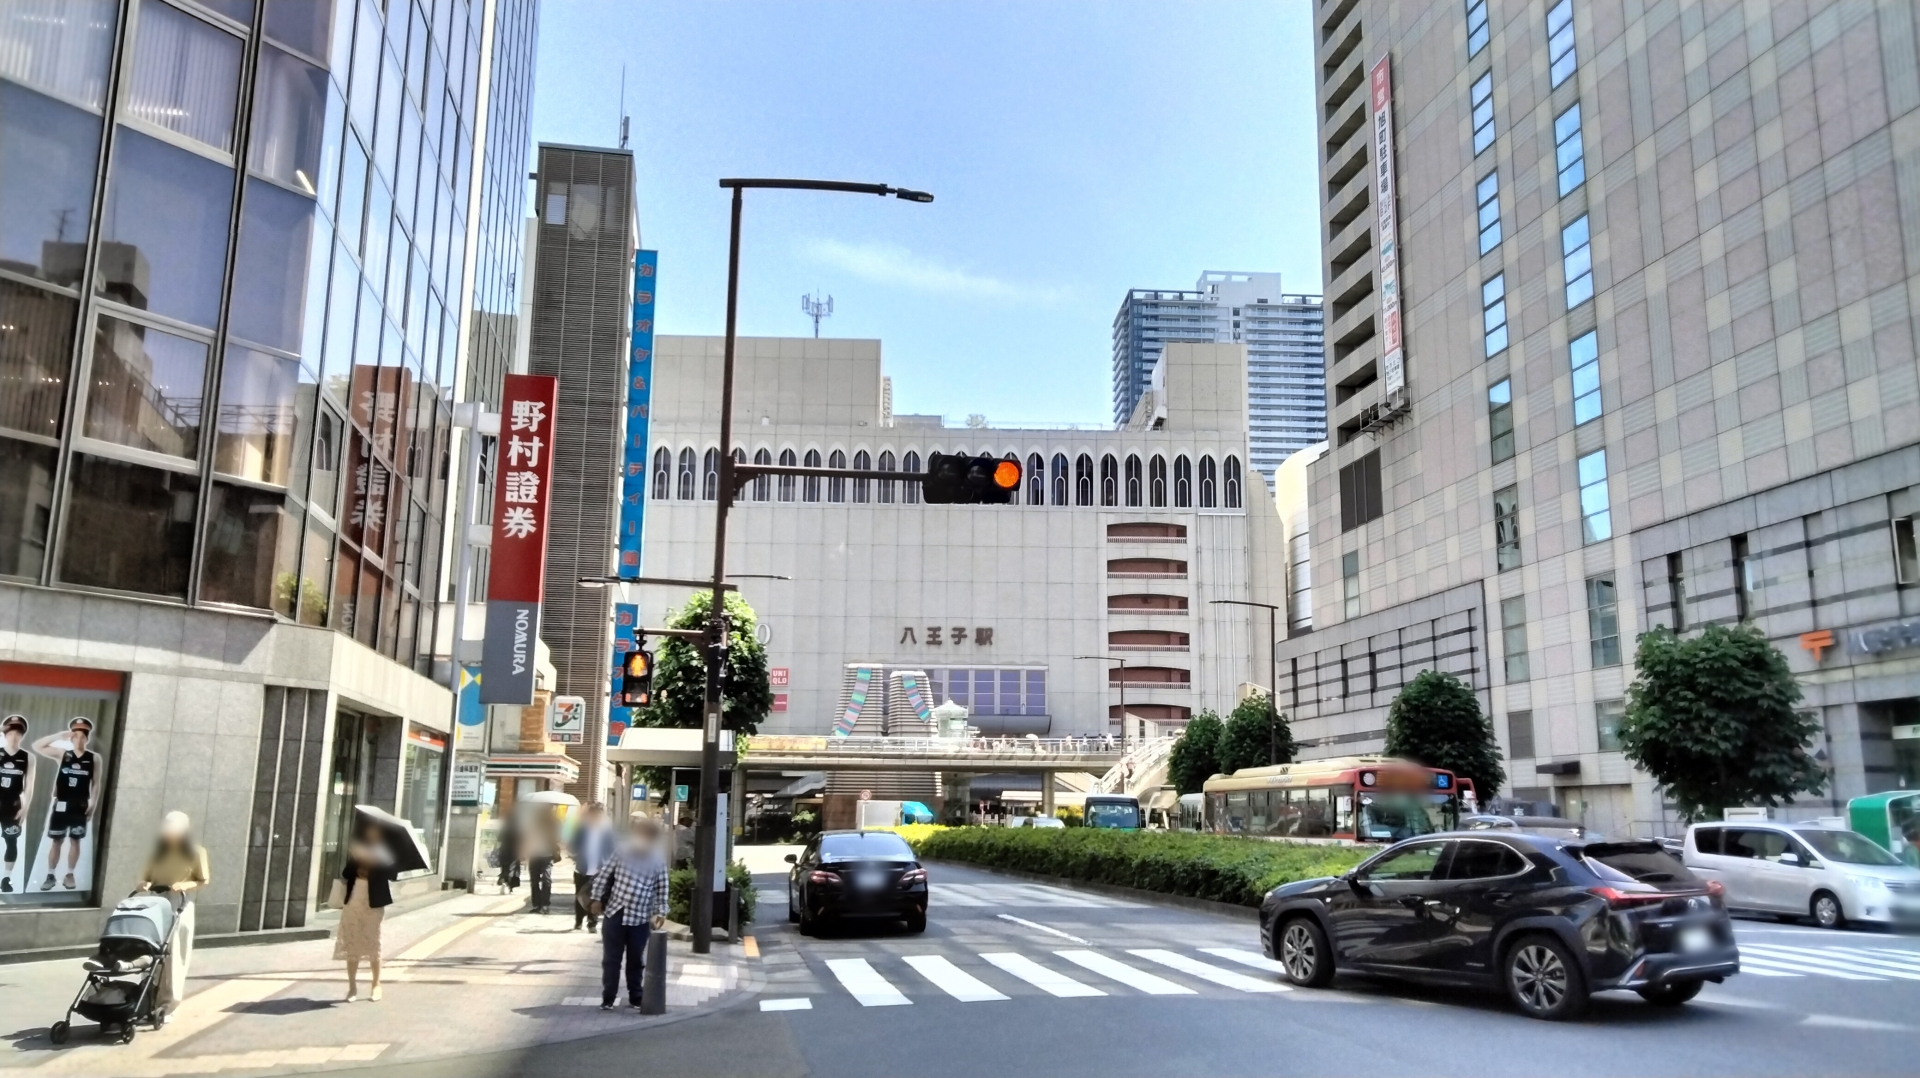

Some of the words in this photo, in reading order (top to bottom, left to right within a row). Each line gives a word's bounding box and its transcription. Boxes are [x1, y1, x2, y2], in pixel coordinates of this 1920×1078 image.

[502, 399, 547, 539] 野村證券
[511, 609, 529, 675] NOMURA
[900, 626, 993, 645] 八王子駅
